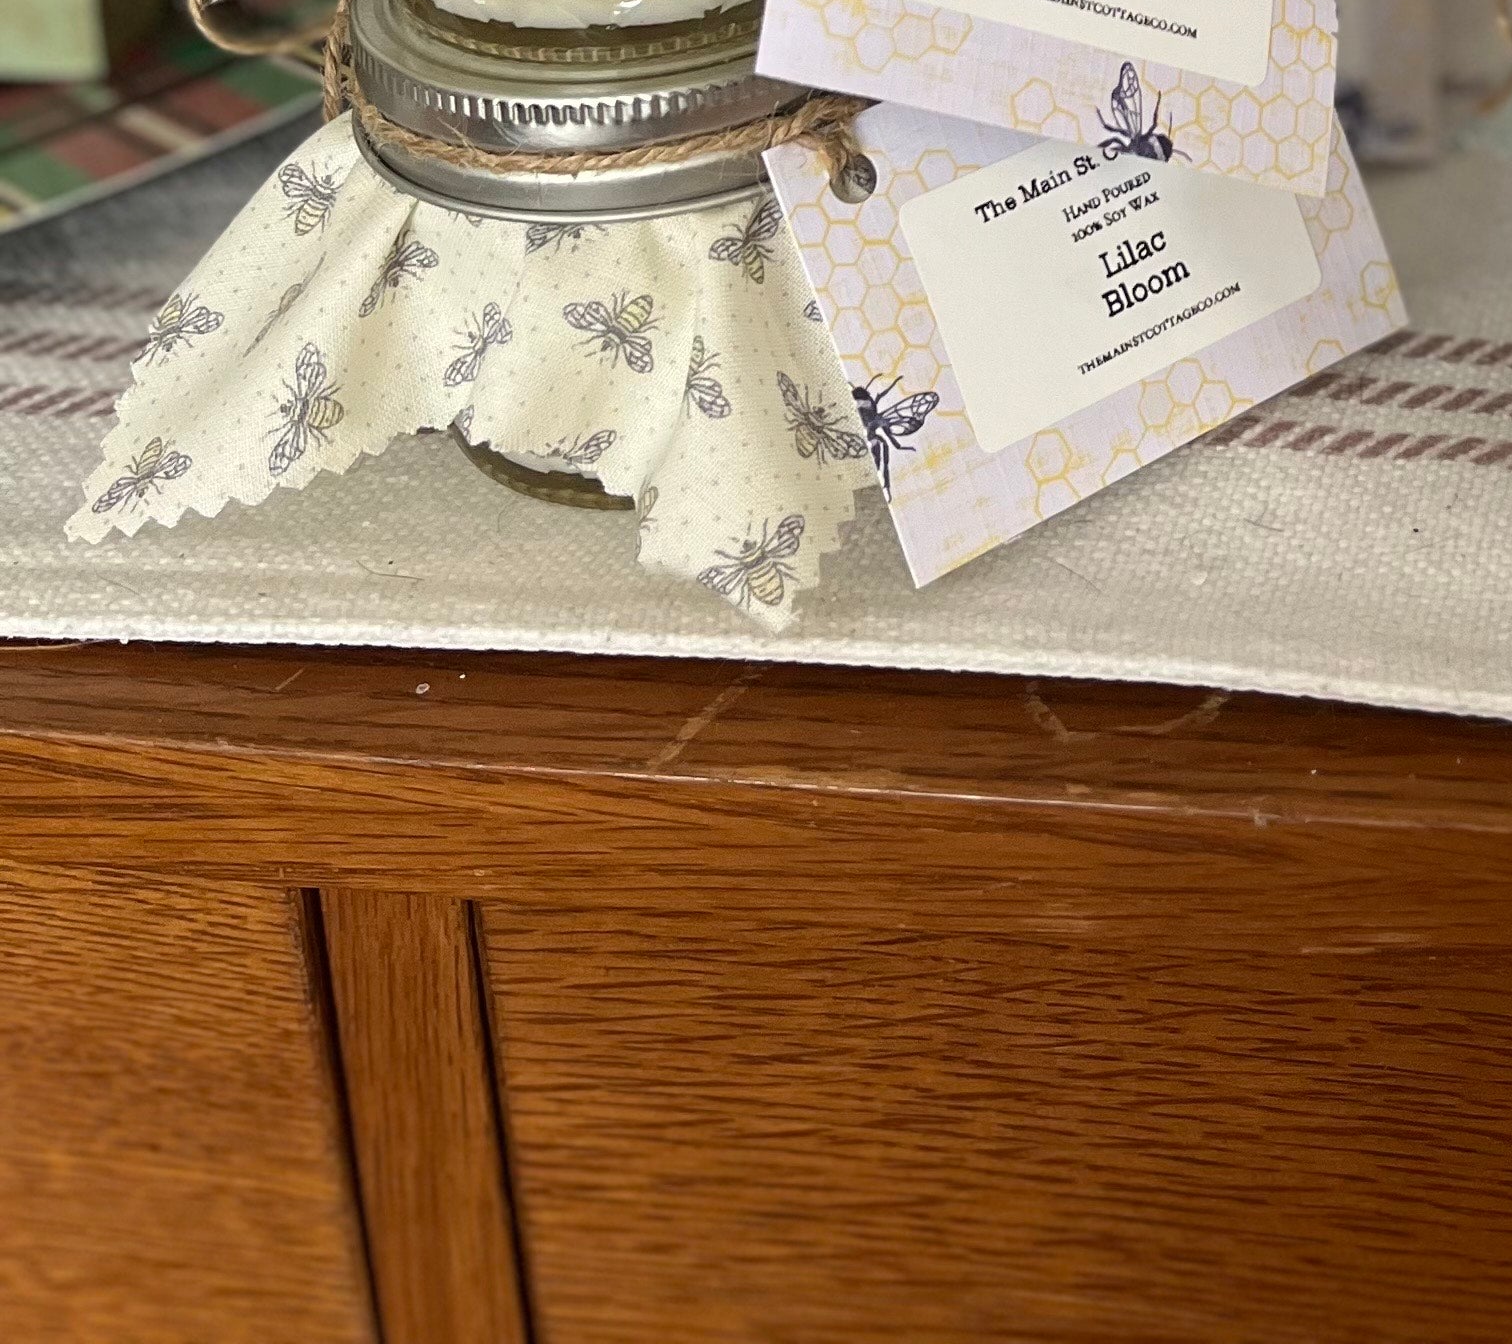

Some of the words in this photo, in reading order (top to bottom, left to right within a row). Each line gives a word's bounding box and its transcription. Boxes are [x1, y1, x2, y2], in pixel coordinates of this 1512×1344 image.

[975, 196, 1017, 223] The
[1018, 170, 1072, 203] Main
[1073, 155, 1100, 176] St.
[1062, 196, 1101, 222] HAND
[1098, 230, 1168, 279] Lilac
[1102, 259, 1190, 318] Bloom
